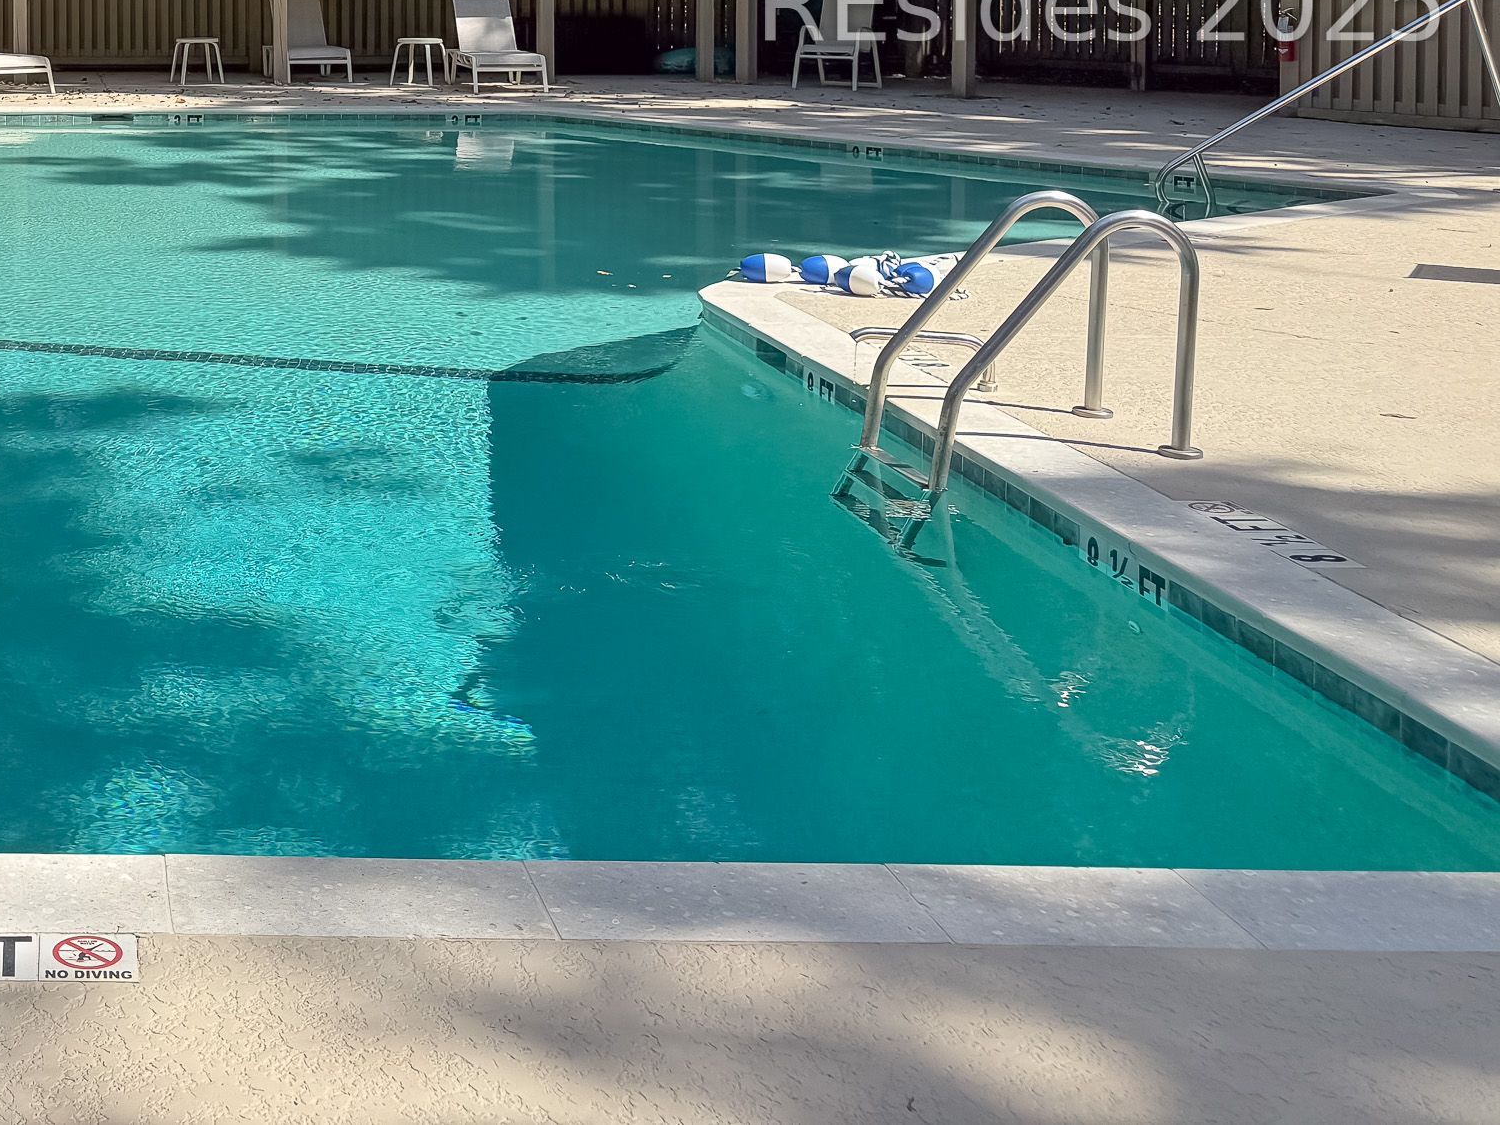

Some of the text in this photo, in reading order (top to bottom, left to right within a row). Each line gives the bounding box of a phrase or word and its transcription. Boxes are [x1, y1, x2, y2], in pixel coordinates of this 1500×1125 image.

[1210, 516, 1289, 531] FT
[1138, 564, 1166, 607] FT
[44, 969, 133, 980] NO DIVING
